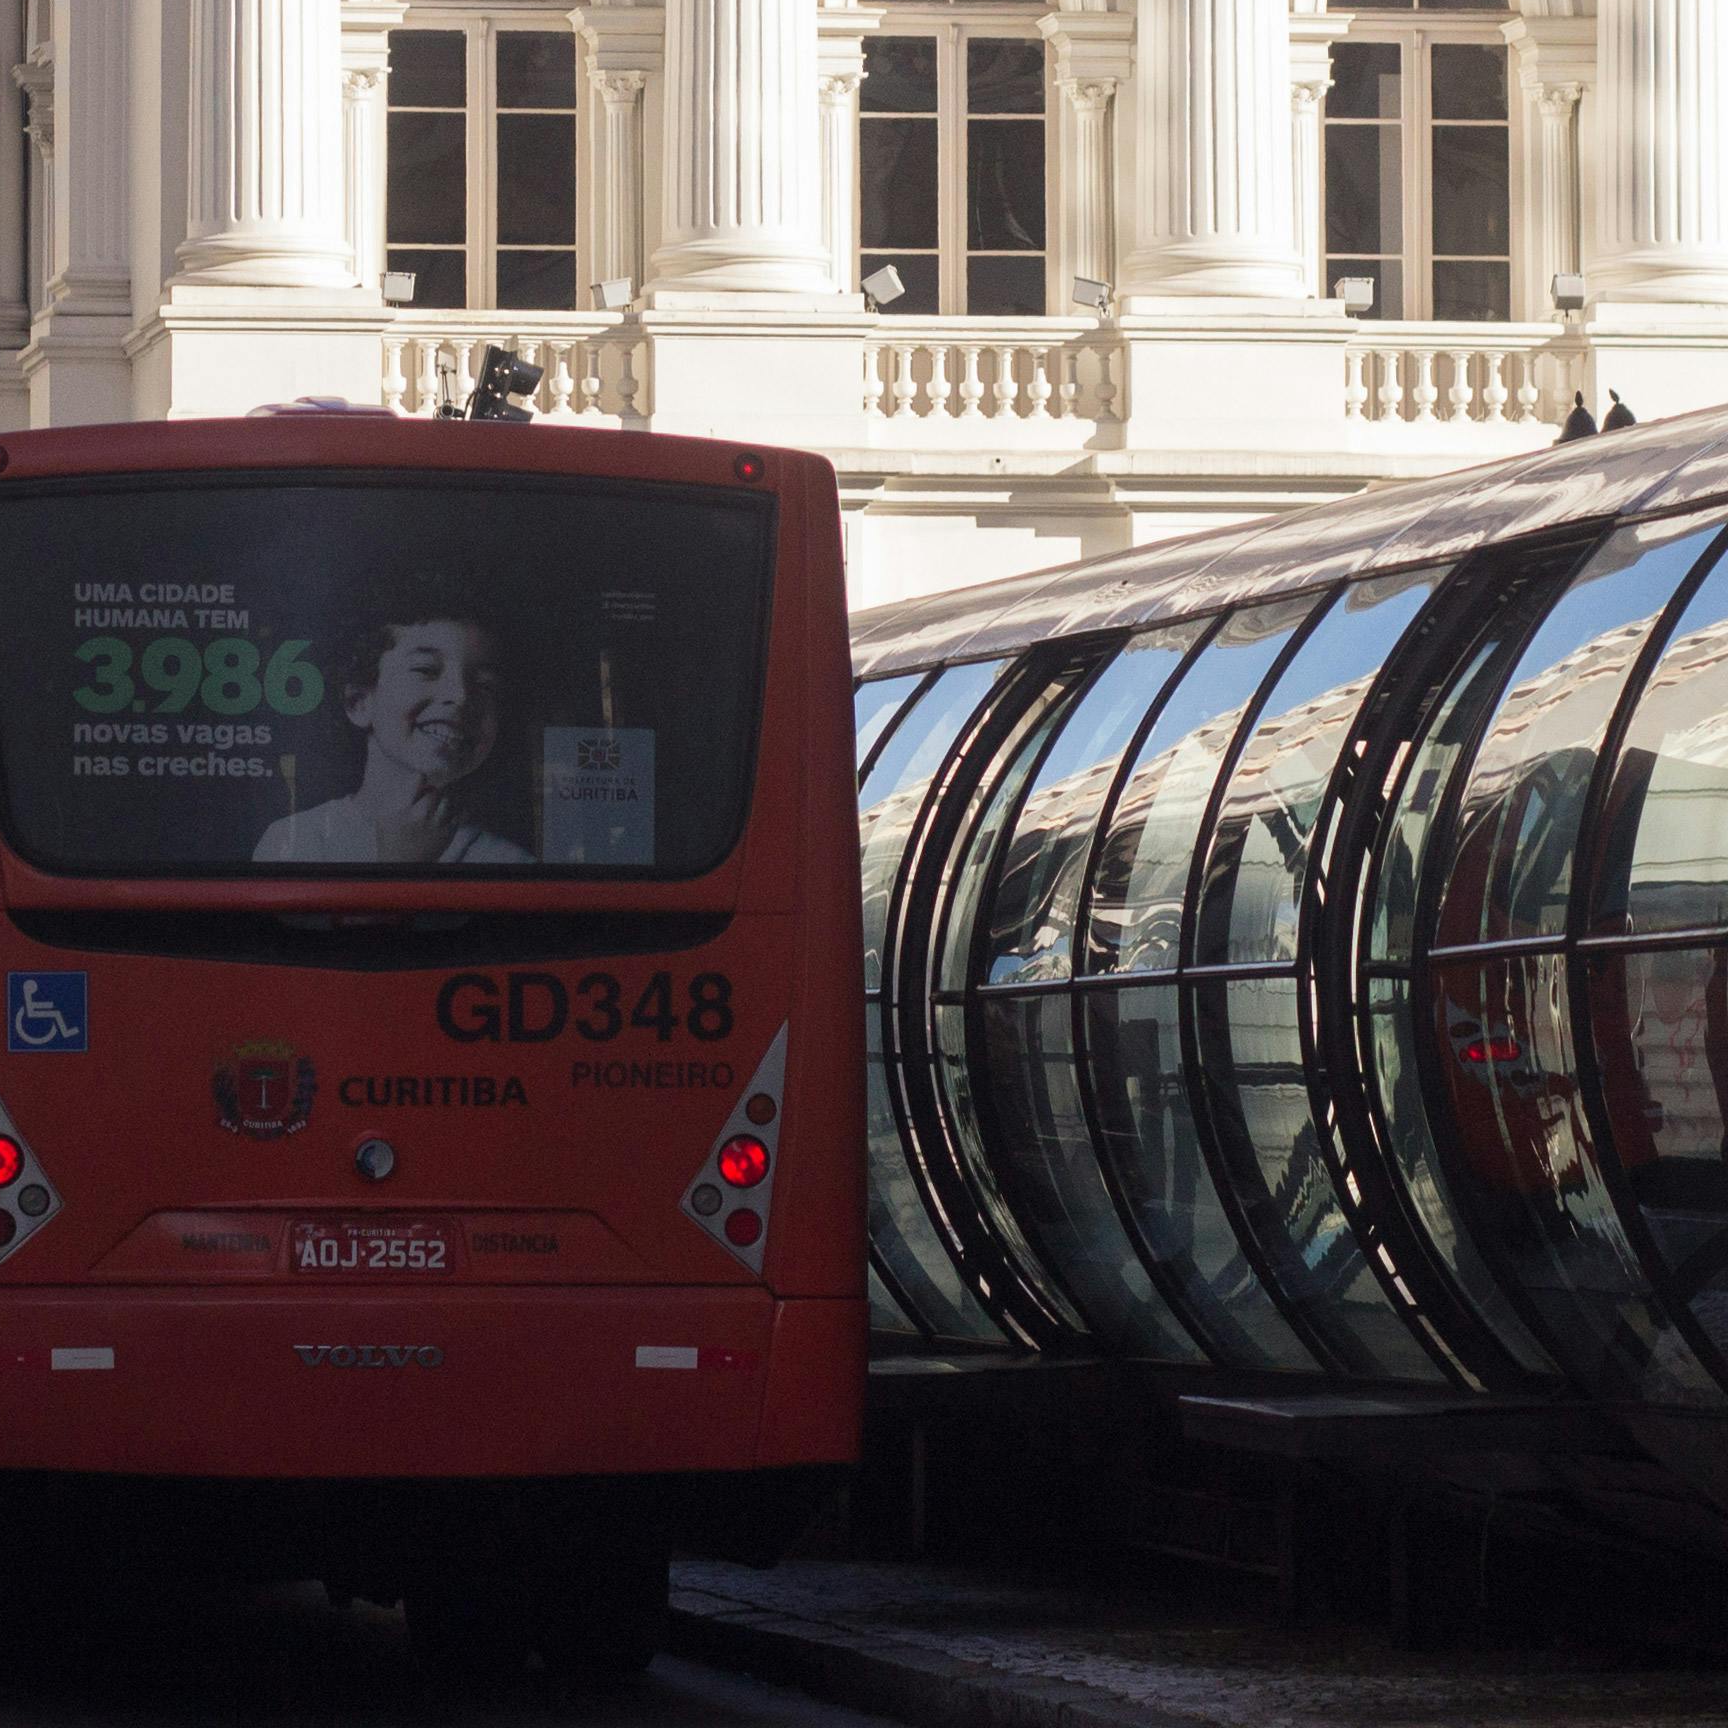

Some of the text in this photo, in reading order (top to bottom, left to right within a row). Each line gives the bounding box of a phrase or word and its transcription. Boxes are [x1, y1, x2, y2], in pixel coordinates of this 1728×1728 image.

[74, 583, 235, 603] UMA CIDADE
[74, 608, 250, 629] HUMANA TEM
[72, 636, 326, 716] 3.986
[73, 722, 272, 750] novas vagas
[73, 752, 274, 777] nas creches.
[558, 787, 639, 801] CURITIBA
[436, 971, 734, 1043] GD348
[571, 1061, 735, 1089] PIONEIRO
[338, 1075, 529, 1108] CURITIBA
[292, 1344, 445, 1367] VOLVO
